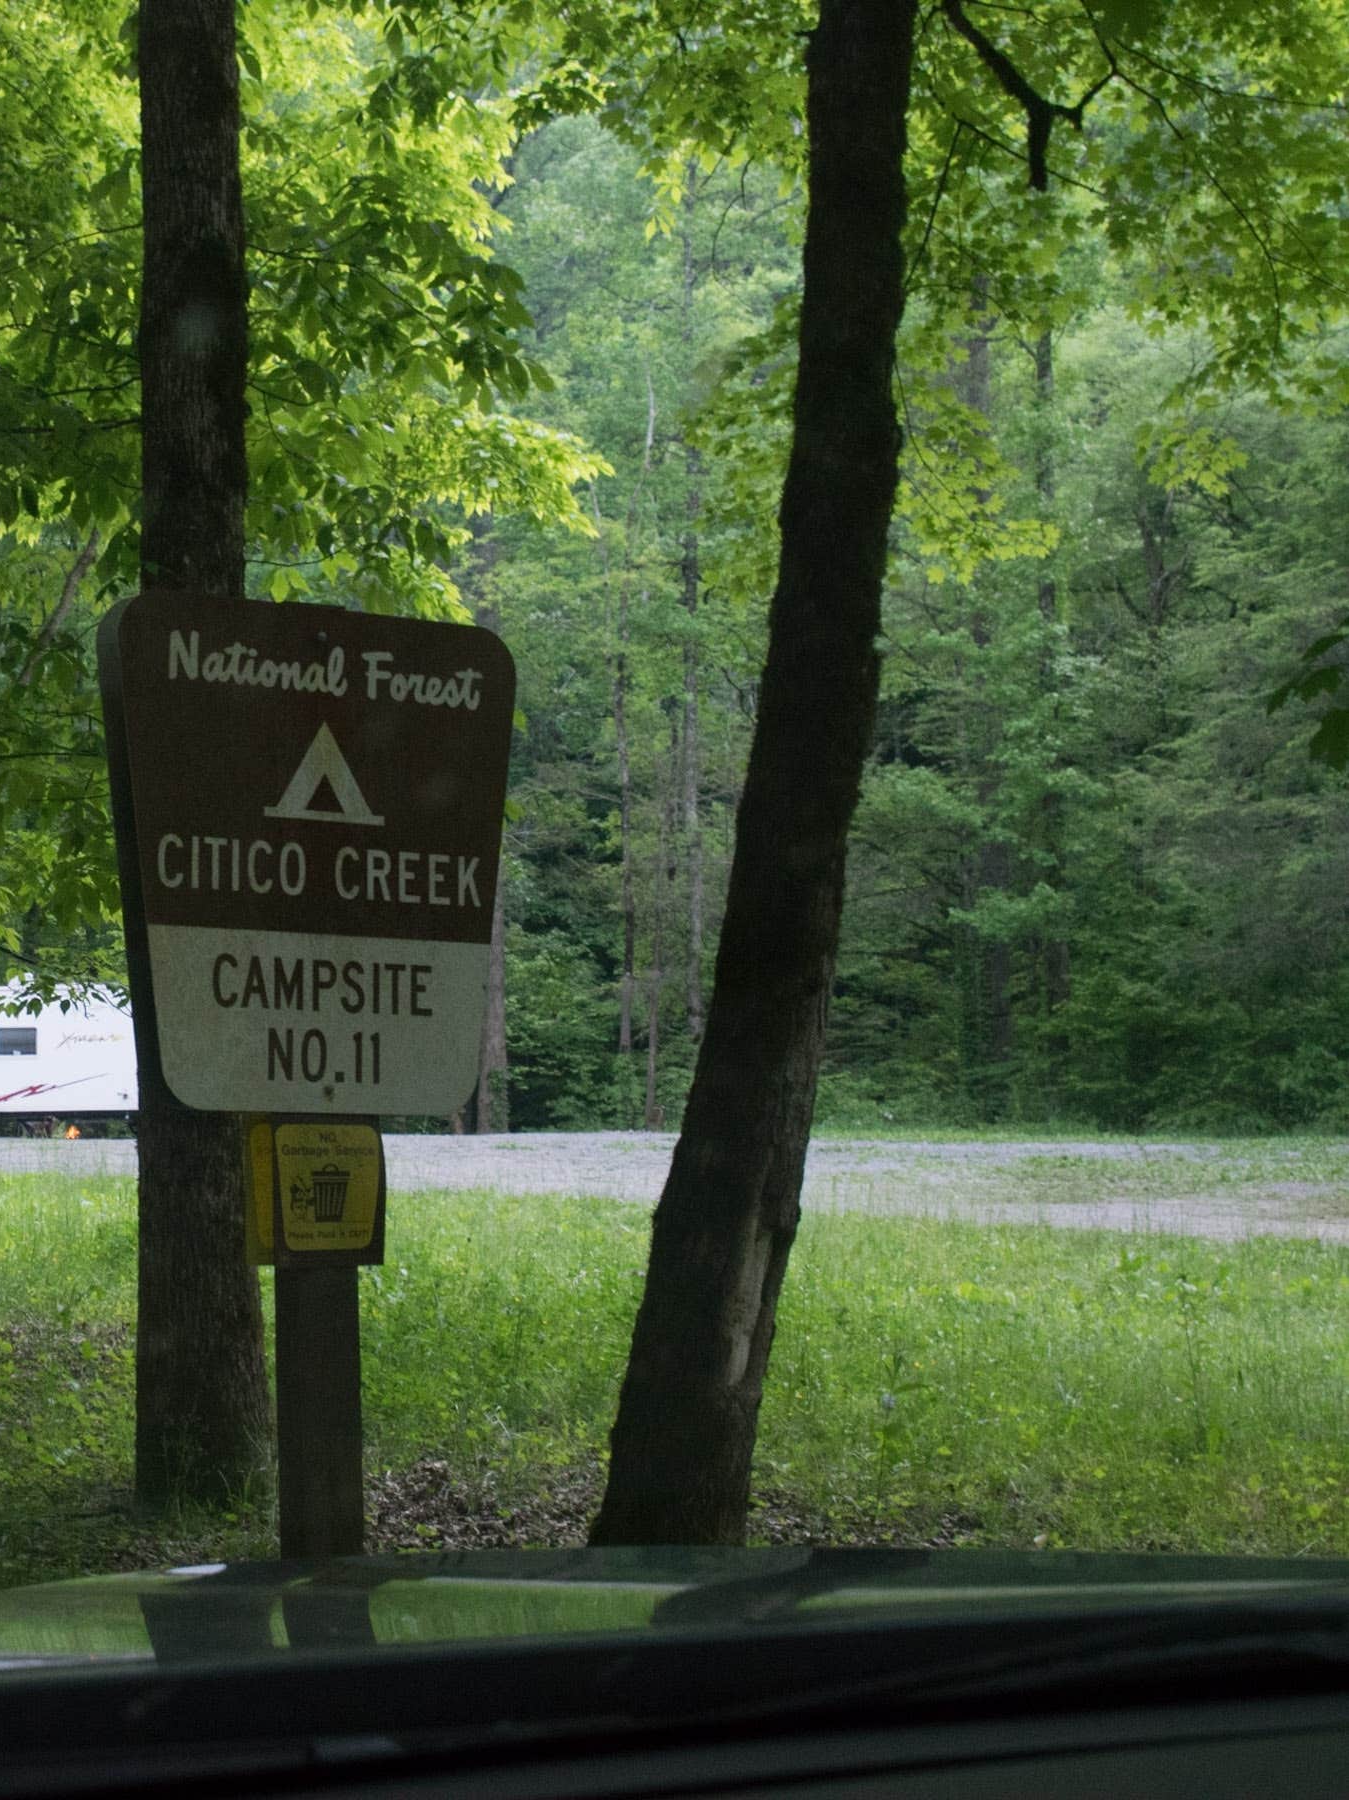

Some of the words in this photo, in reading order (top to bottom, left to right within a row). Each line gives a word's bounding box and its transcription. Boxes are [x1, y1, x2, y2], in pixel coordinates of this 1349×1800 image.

[168, 630, 347, 697] National
[362, 651, 484, 711] Forest
[157, 833, 306, 896] CITICO
[335, 846, 481, 908] CREEK
[212, 953, 434, 1018] CAMPSITE
[281, 1144, 330, 1158] Garbage
